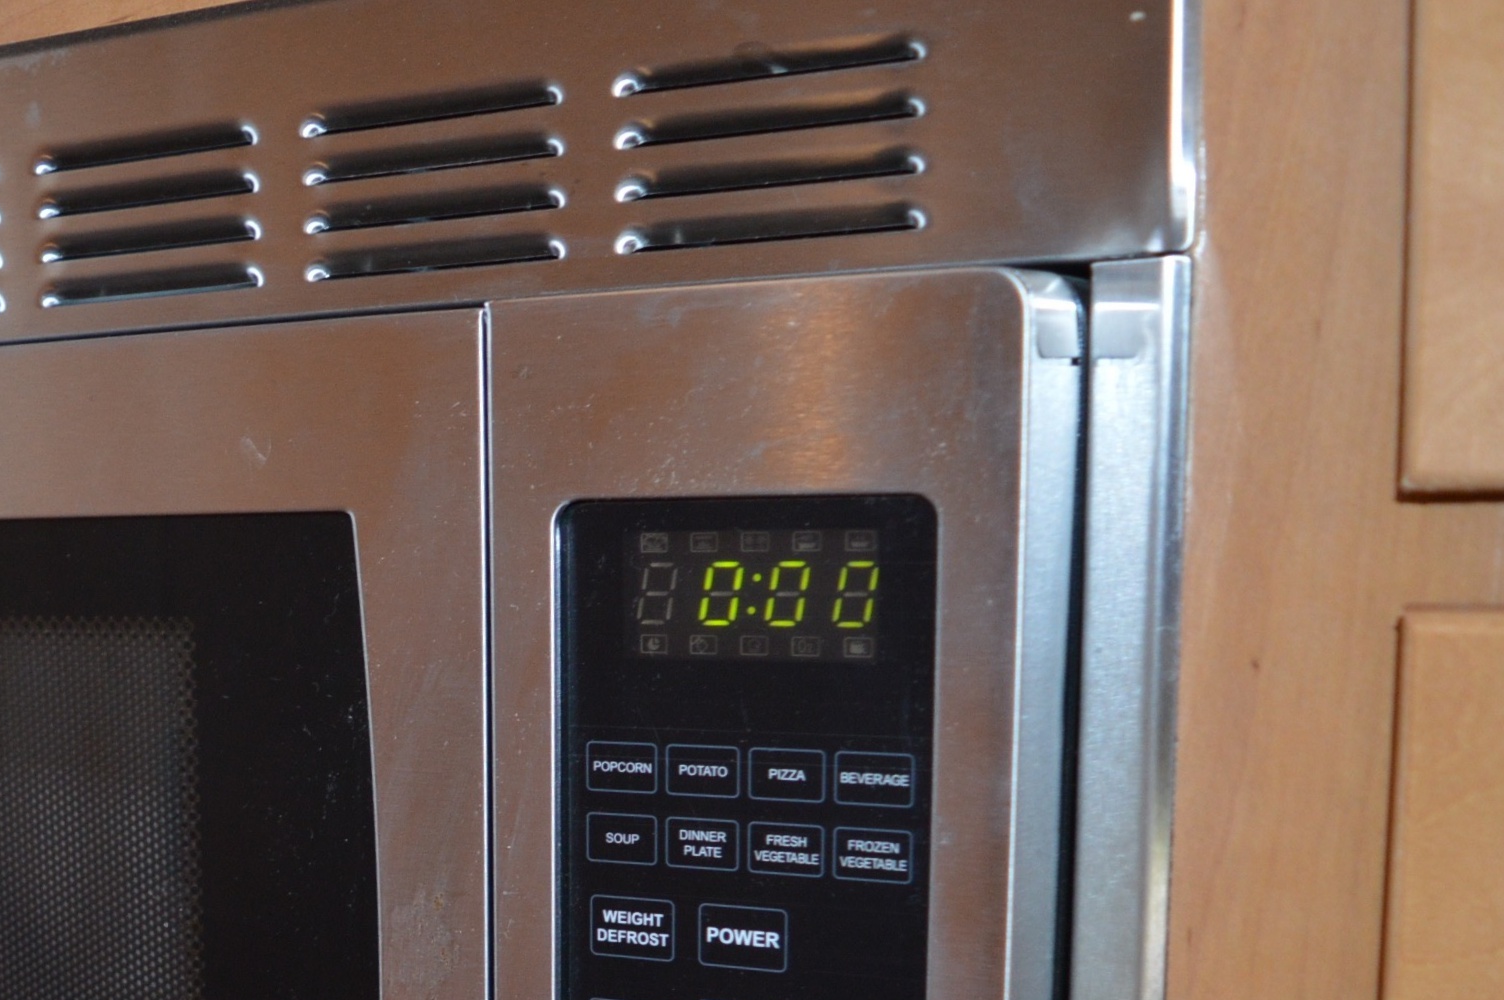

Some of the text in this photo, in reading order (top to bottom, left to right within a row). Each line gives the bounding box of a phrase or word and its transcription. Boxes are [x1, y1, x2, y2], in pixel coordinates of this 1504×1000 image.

[699, 561, 879, 627] 0:00
[593, 760, 653, 775] POPCORN
[678, 763, 728, 778] POTATO
[768, 767, 806, 782] PIZZA
[840, 771, 910, 787] BEVERAGE
[605, 832, 640, 845] SOUP
[679, 829, 727, 843] DINNER
[766, 834, 808, 849] FRESH
[683, 845, 722, 859] PLATE
[847, 839, 900, 854] FROZEN
[754, 850, 820, 866] VEGETABLE
[839, 856, 908, 872] VEGETABLE
[602, 909, 664, 928] WEIGHT
[597, 928, 669, 948] DEFROST
[706, 926, 780, 949] POWER
